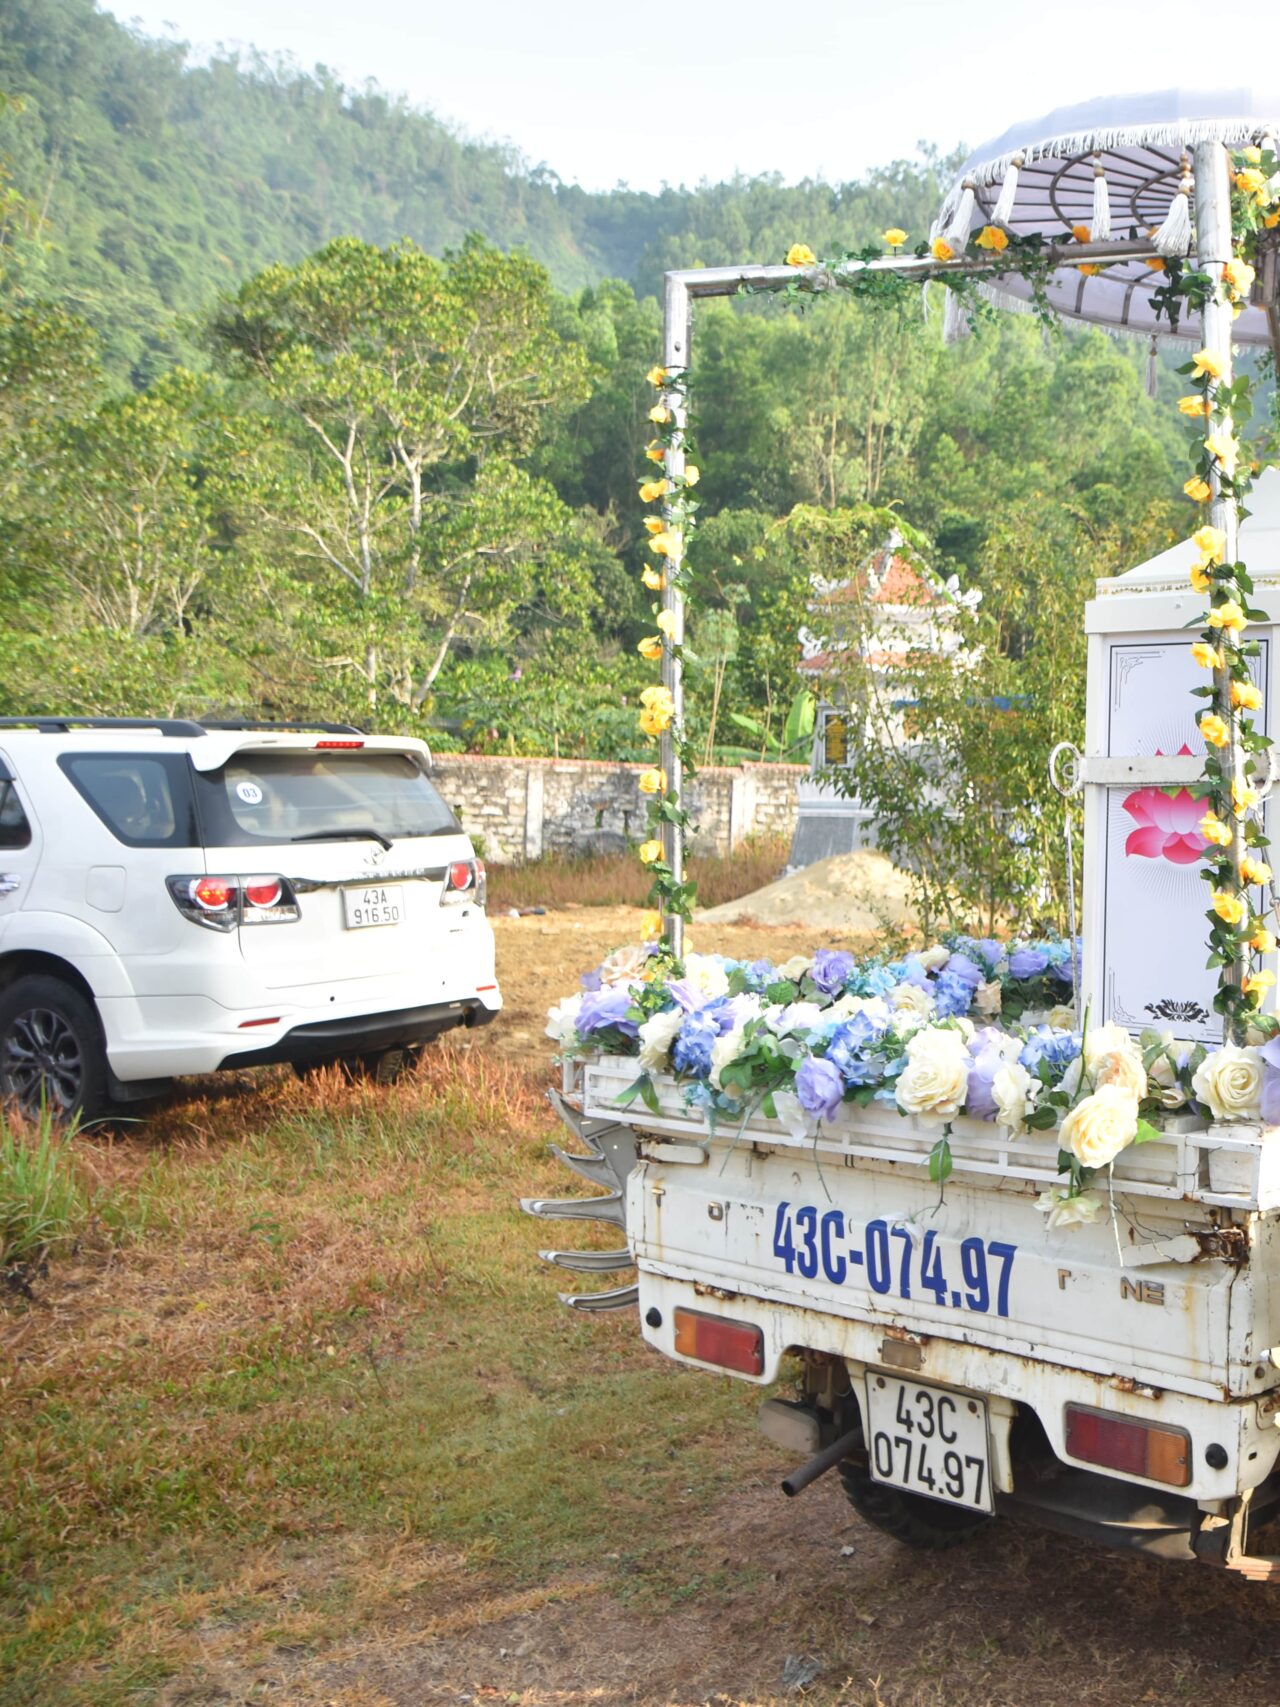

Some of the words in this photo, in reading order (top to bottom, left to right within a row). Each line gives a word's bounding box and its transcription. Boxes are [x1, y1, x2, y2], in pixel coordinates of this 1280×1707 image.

[353, 905, 400, 925] 916.50
[363, 888, 388, 905] 43A
[773, 1201, 1019, 1317] 43C-074.97
[896, 1385, 957, 1444] 43C
[874, 1431, 985, 1505] 074.97
